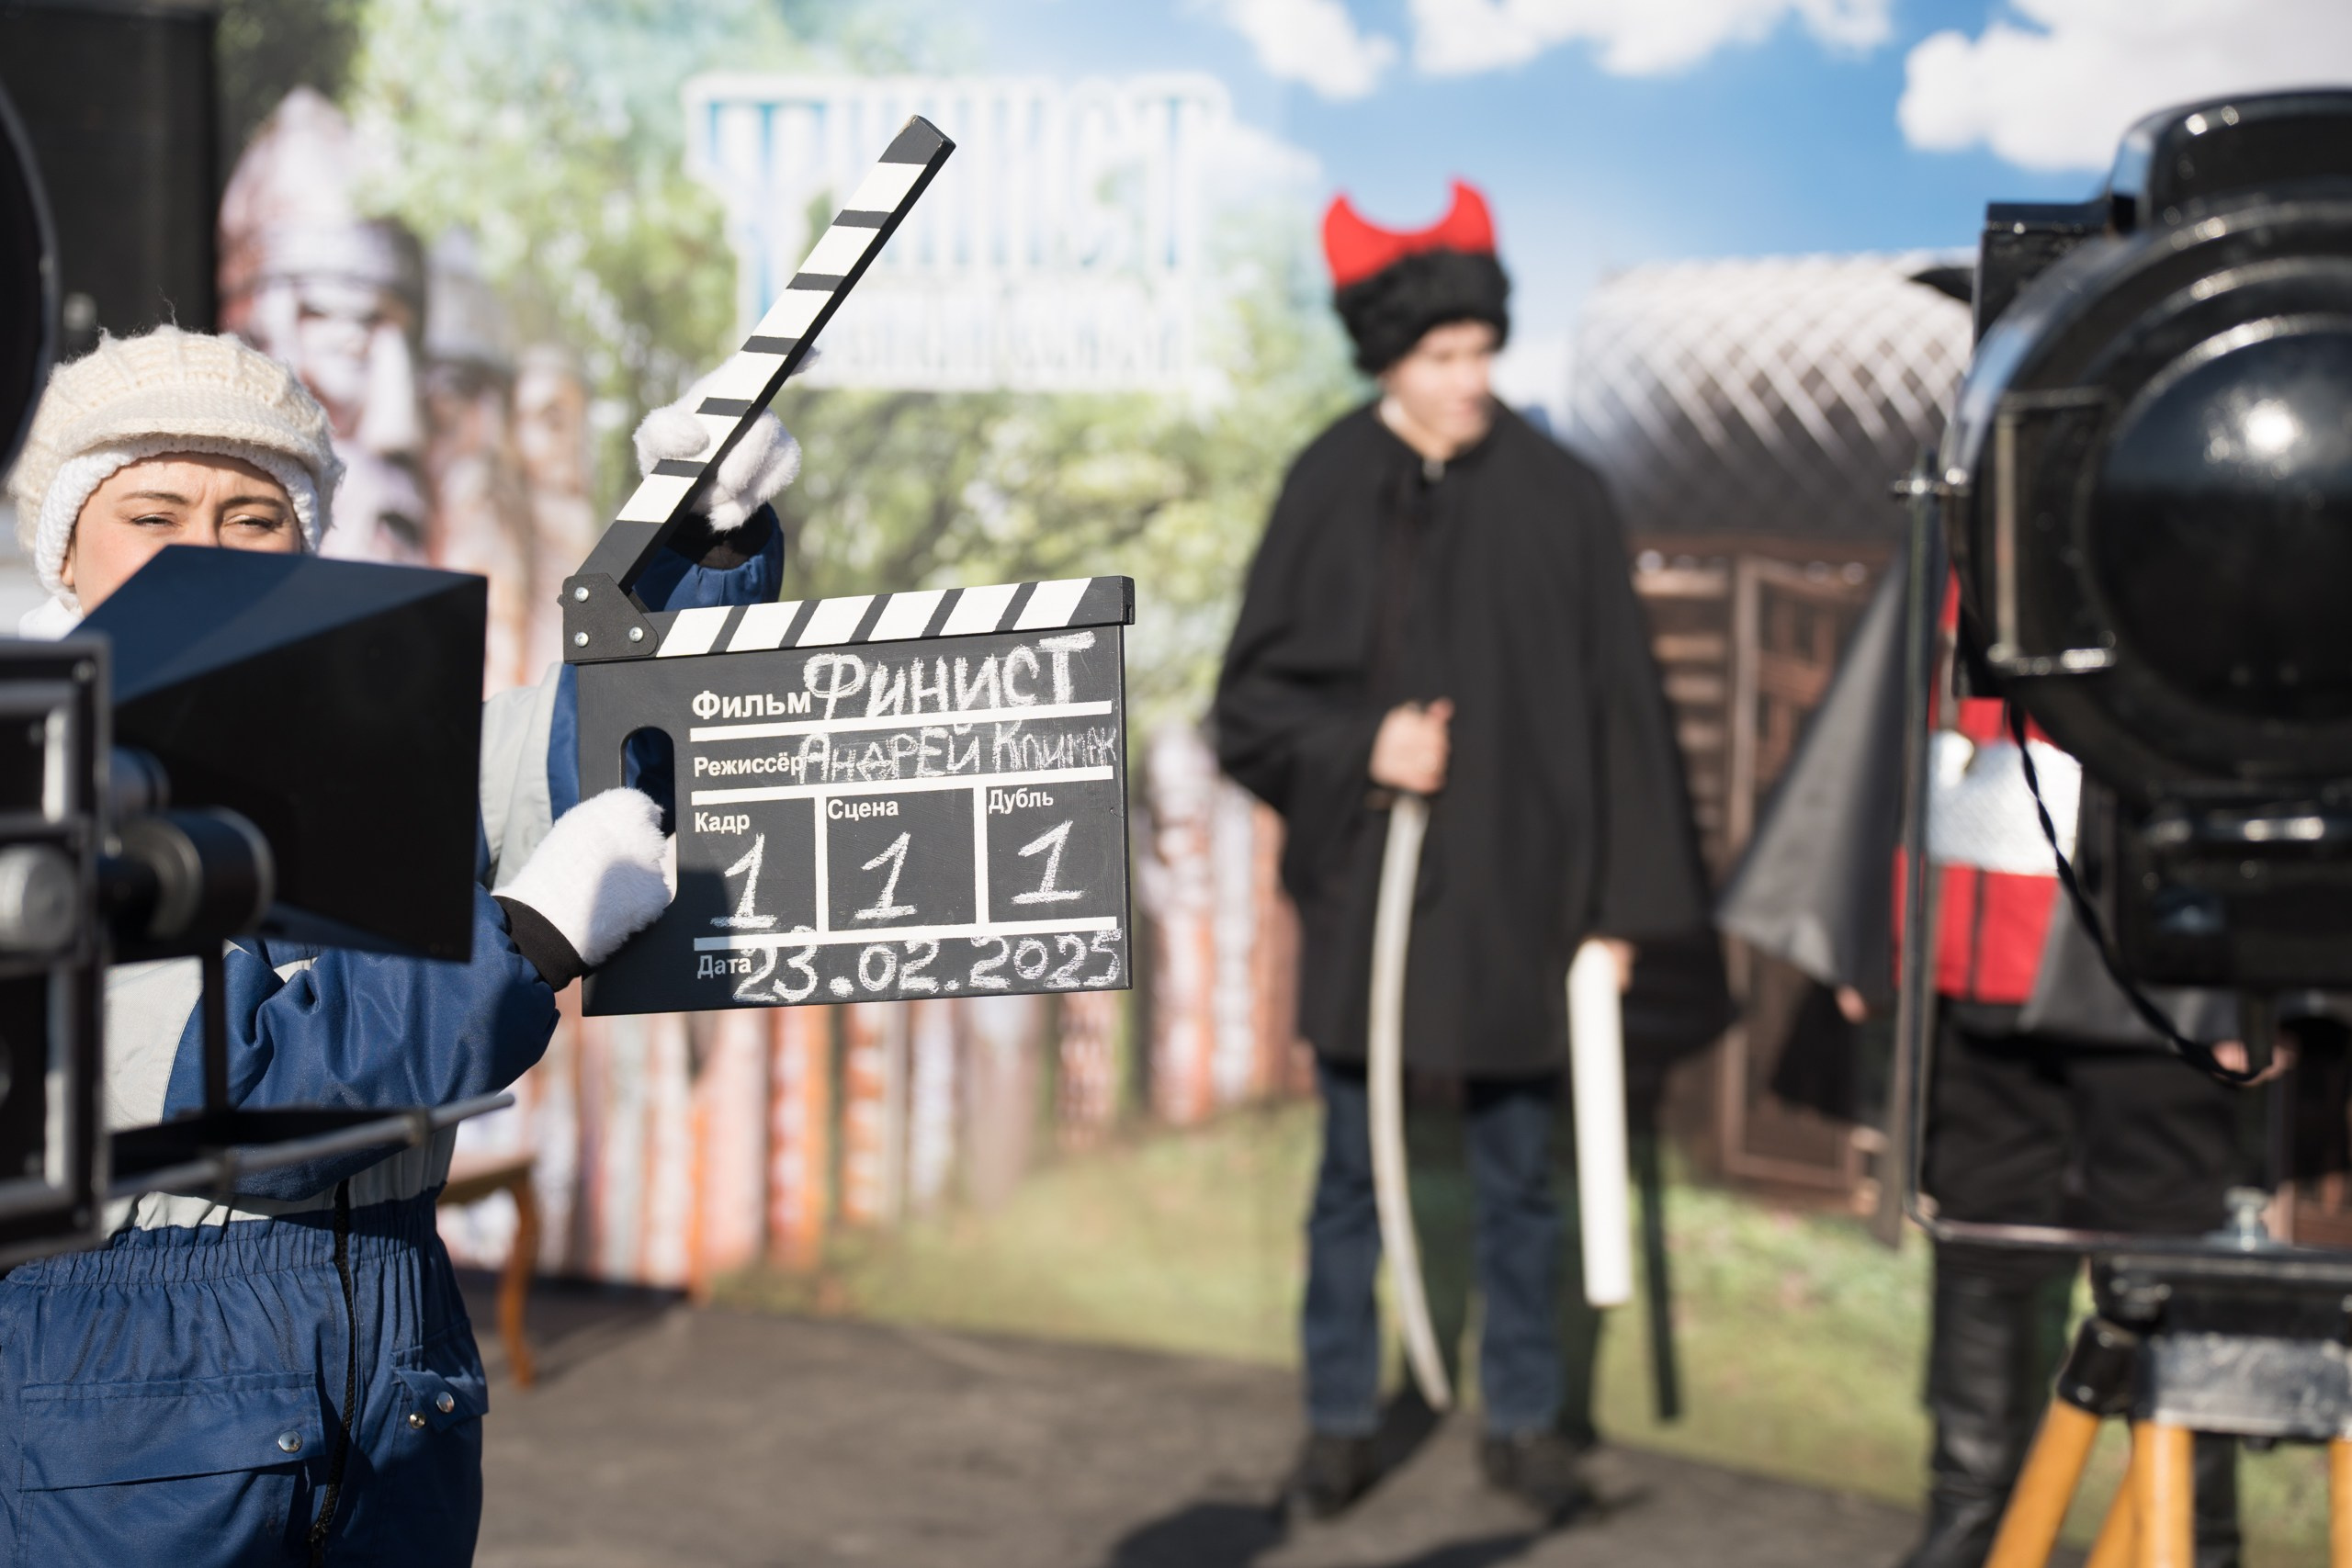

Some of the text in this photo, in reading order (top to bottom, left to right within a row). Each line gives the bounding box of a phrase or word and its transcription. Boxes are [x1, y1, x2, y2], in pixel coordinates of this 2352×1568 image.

[802, 631, 1096, 721] ФИНИСТ
[692, 690, 810, 719] Фильм
[694, 751, 804, 778] Режиссёр
[827, 799, 899, 820] Сцена
[988, 787, 1055, 814] Дубль
[694, 811, 751, 835] Кадр
[854, 830, 918, 920] 1
[1011, 819, 1086, 905] 1
[709, 832, 778, 930] 1
[696, 953, 752, 979] Дата
[732, 925, 1123, 1003] 23.02.2025
